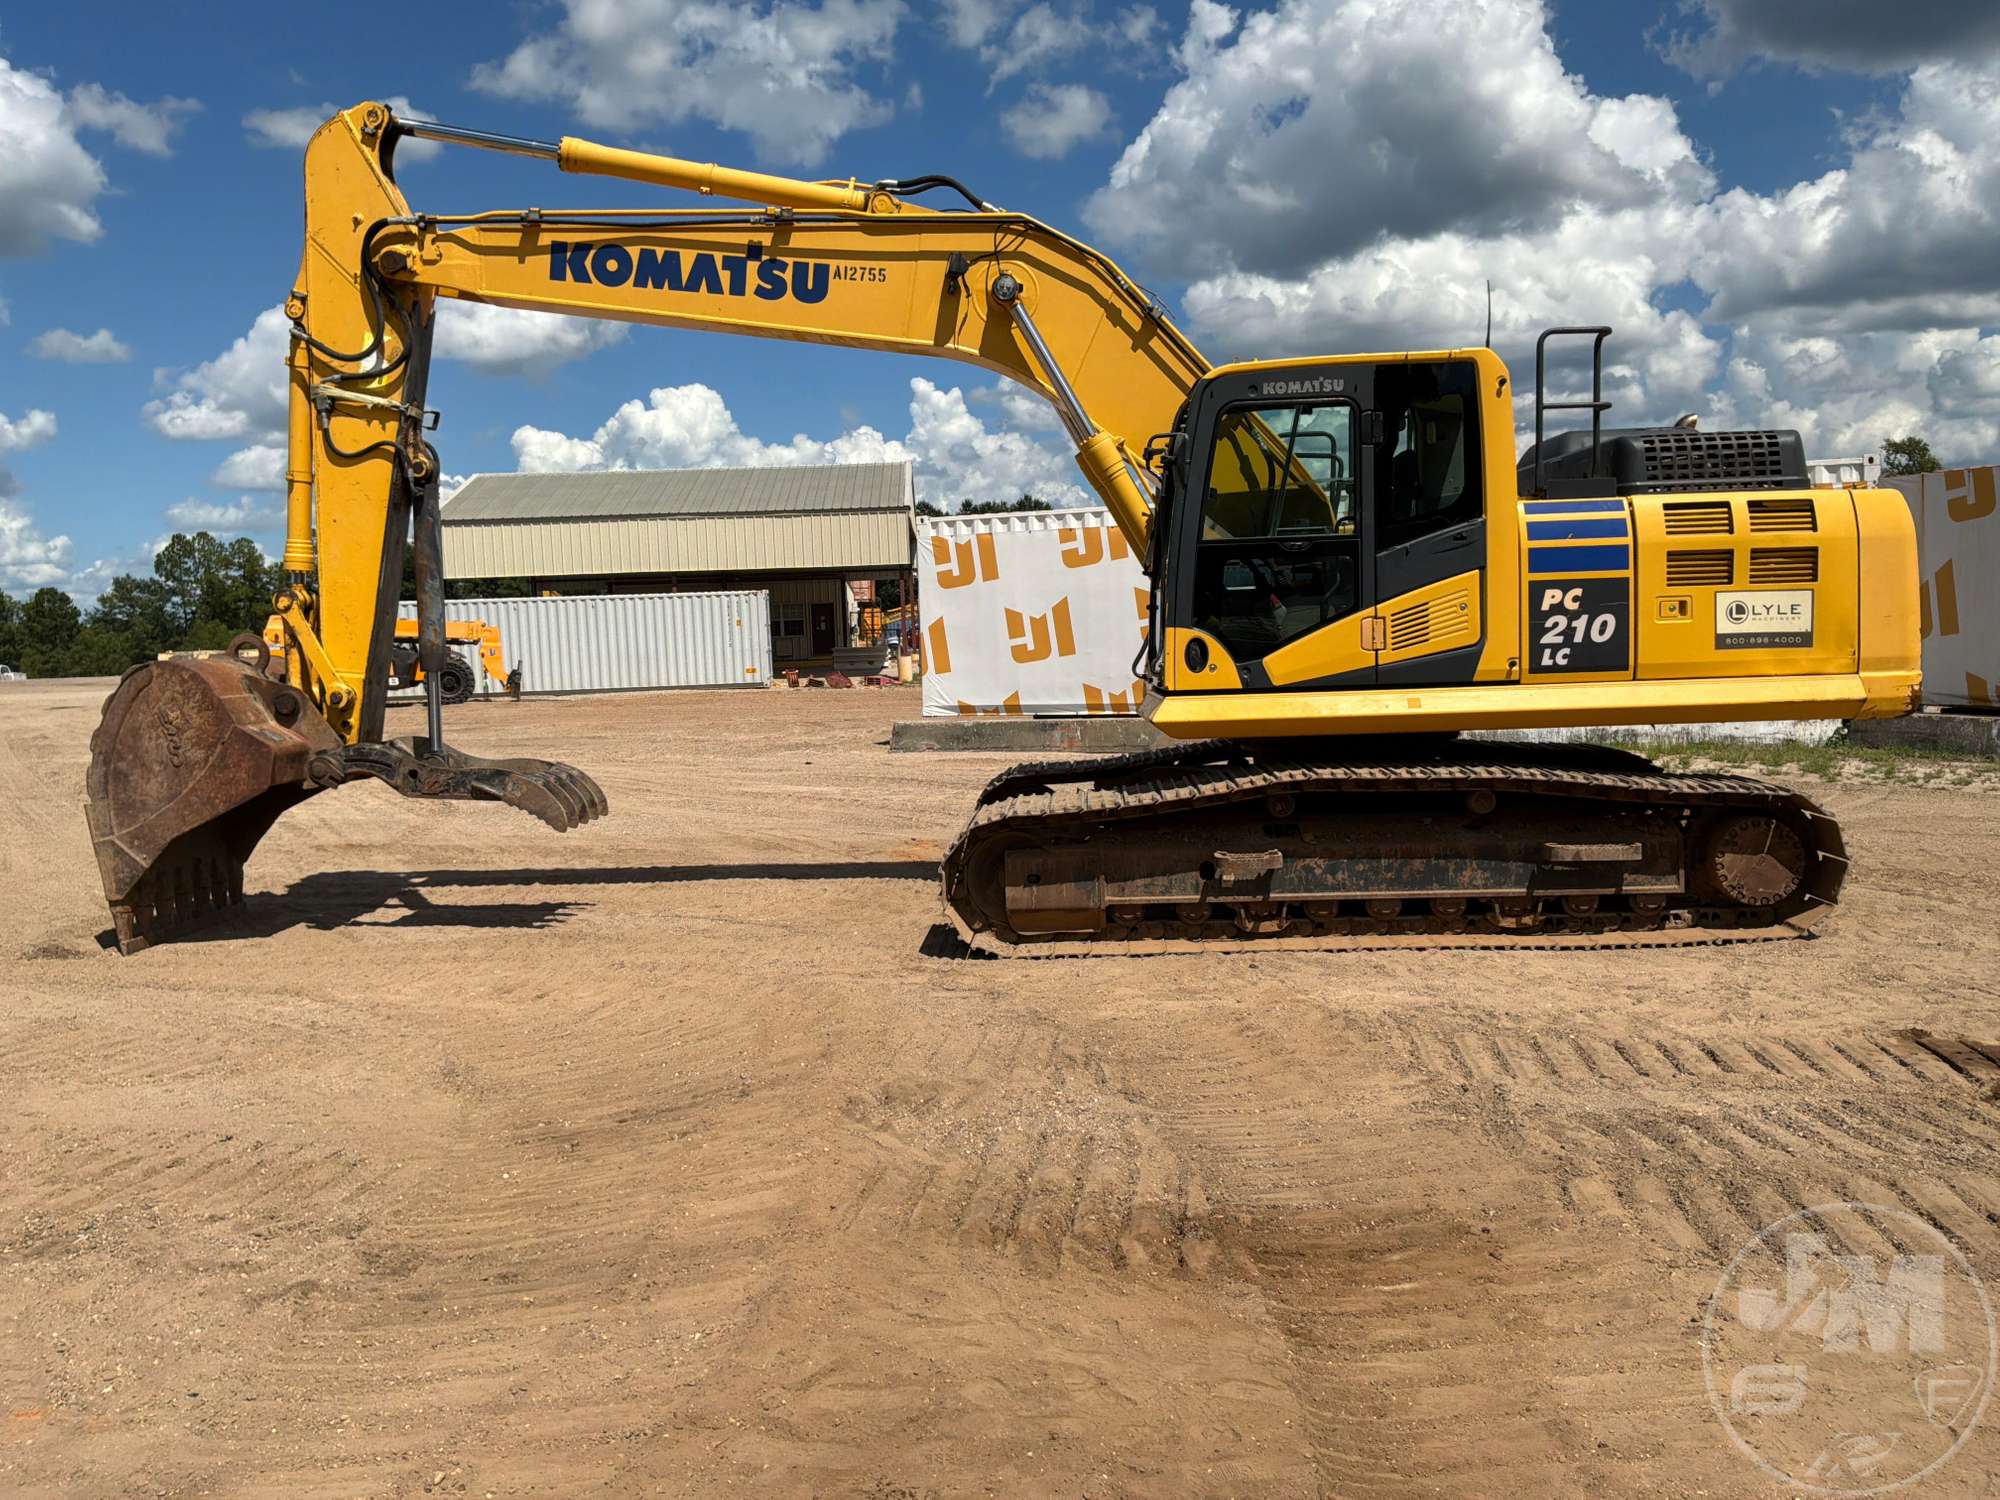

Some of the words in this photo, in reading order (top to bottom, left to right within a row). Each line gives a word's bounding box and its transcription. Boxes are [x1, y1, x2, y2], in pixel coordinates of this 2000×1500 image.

[549, 239, 830, 304] KOMATSU
[833, 266, 887, 283] A12755
[1263, 376, 1345, 395] KOMATSU
[1540, 587, 1583, 611] PC
[1752, 603, 1801, 615] LYLE
[1539, 613, 1616, 644] 210
[1540, 647, 1571, 666] LC
